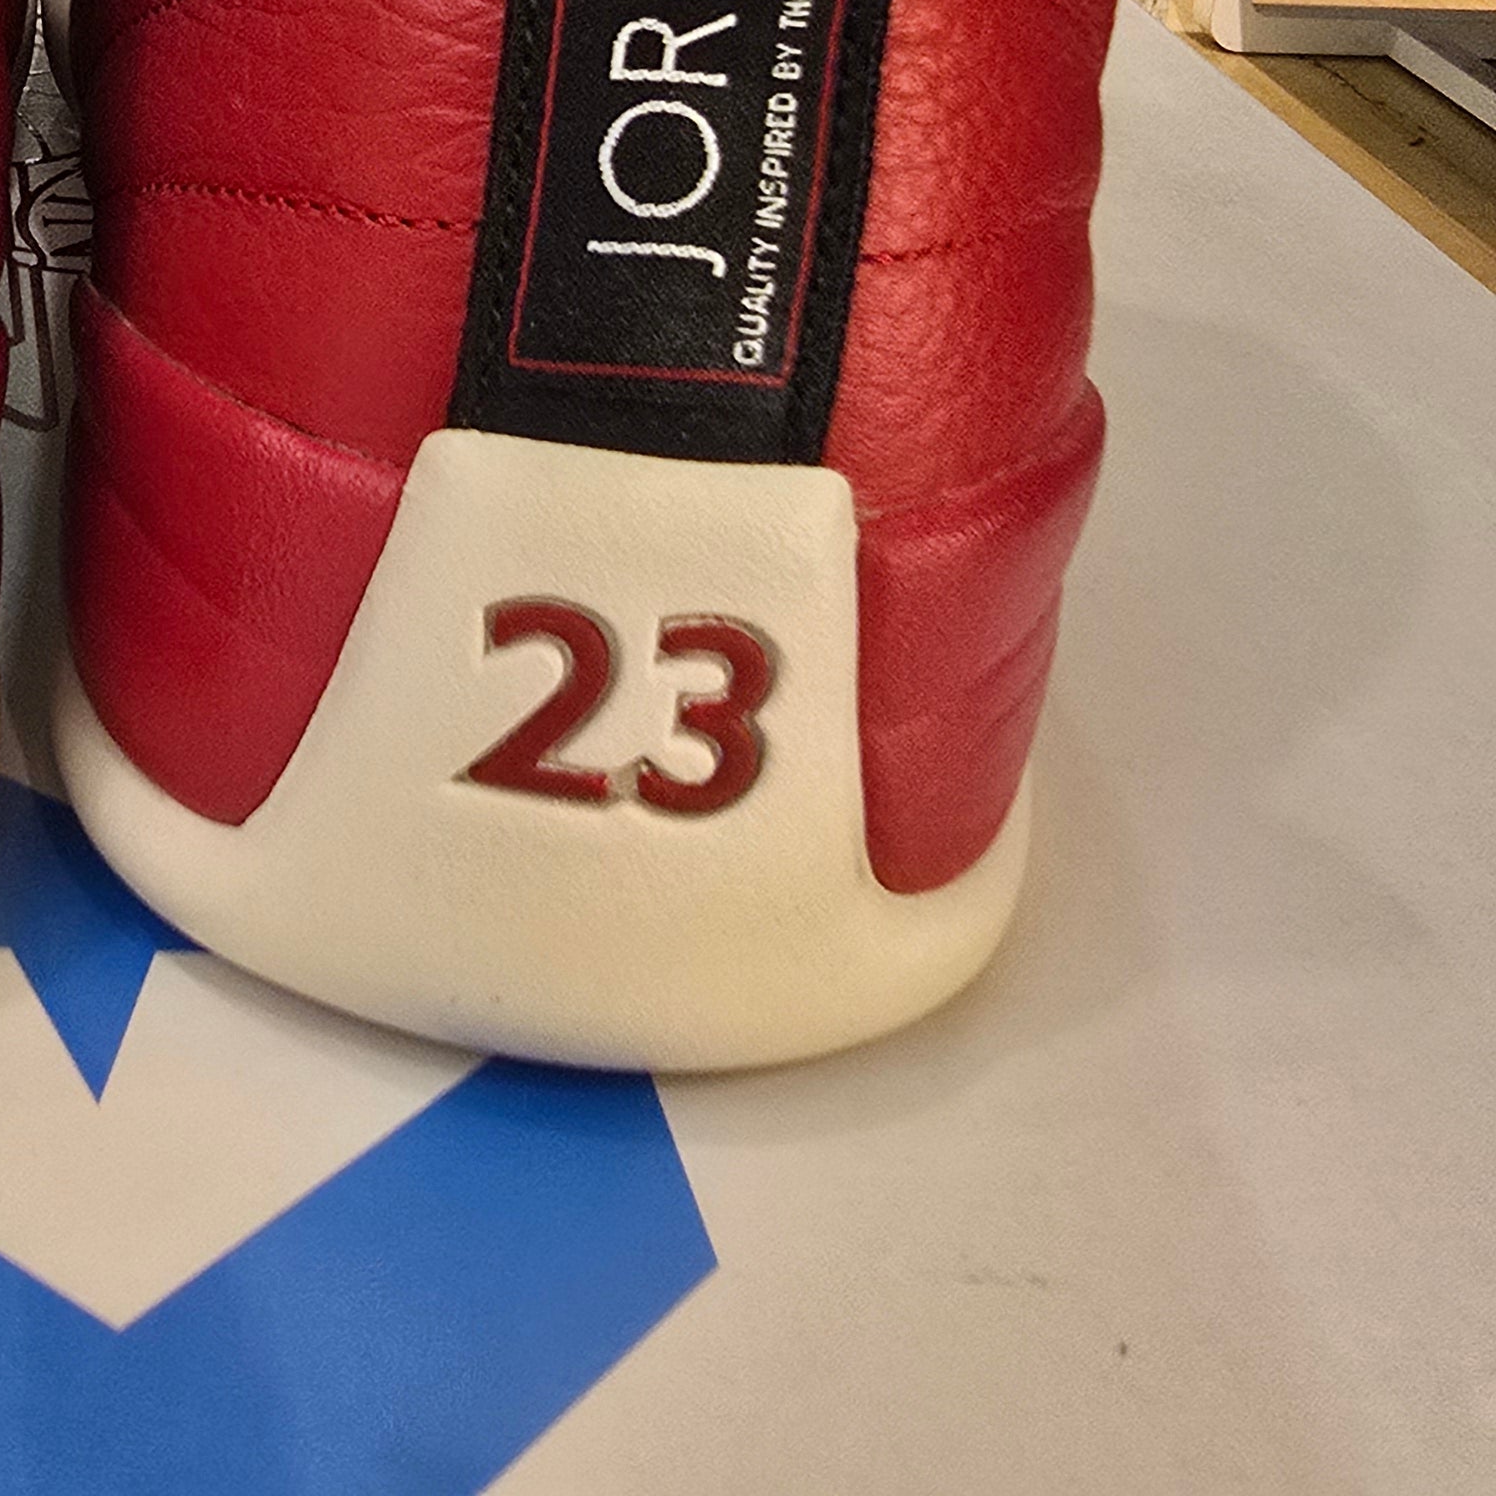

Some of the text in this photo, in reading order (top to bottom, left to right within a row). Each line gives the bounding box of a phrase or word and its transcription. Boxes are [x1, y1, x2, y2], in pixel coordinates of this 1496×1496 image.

[771, 42, 803, 80] BY
[754, 92, 799, 229] INSPIRED
[732, 236, 780, 366] QUALITY
[452, 595, 784, 816] 23
